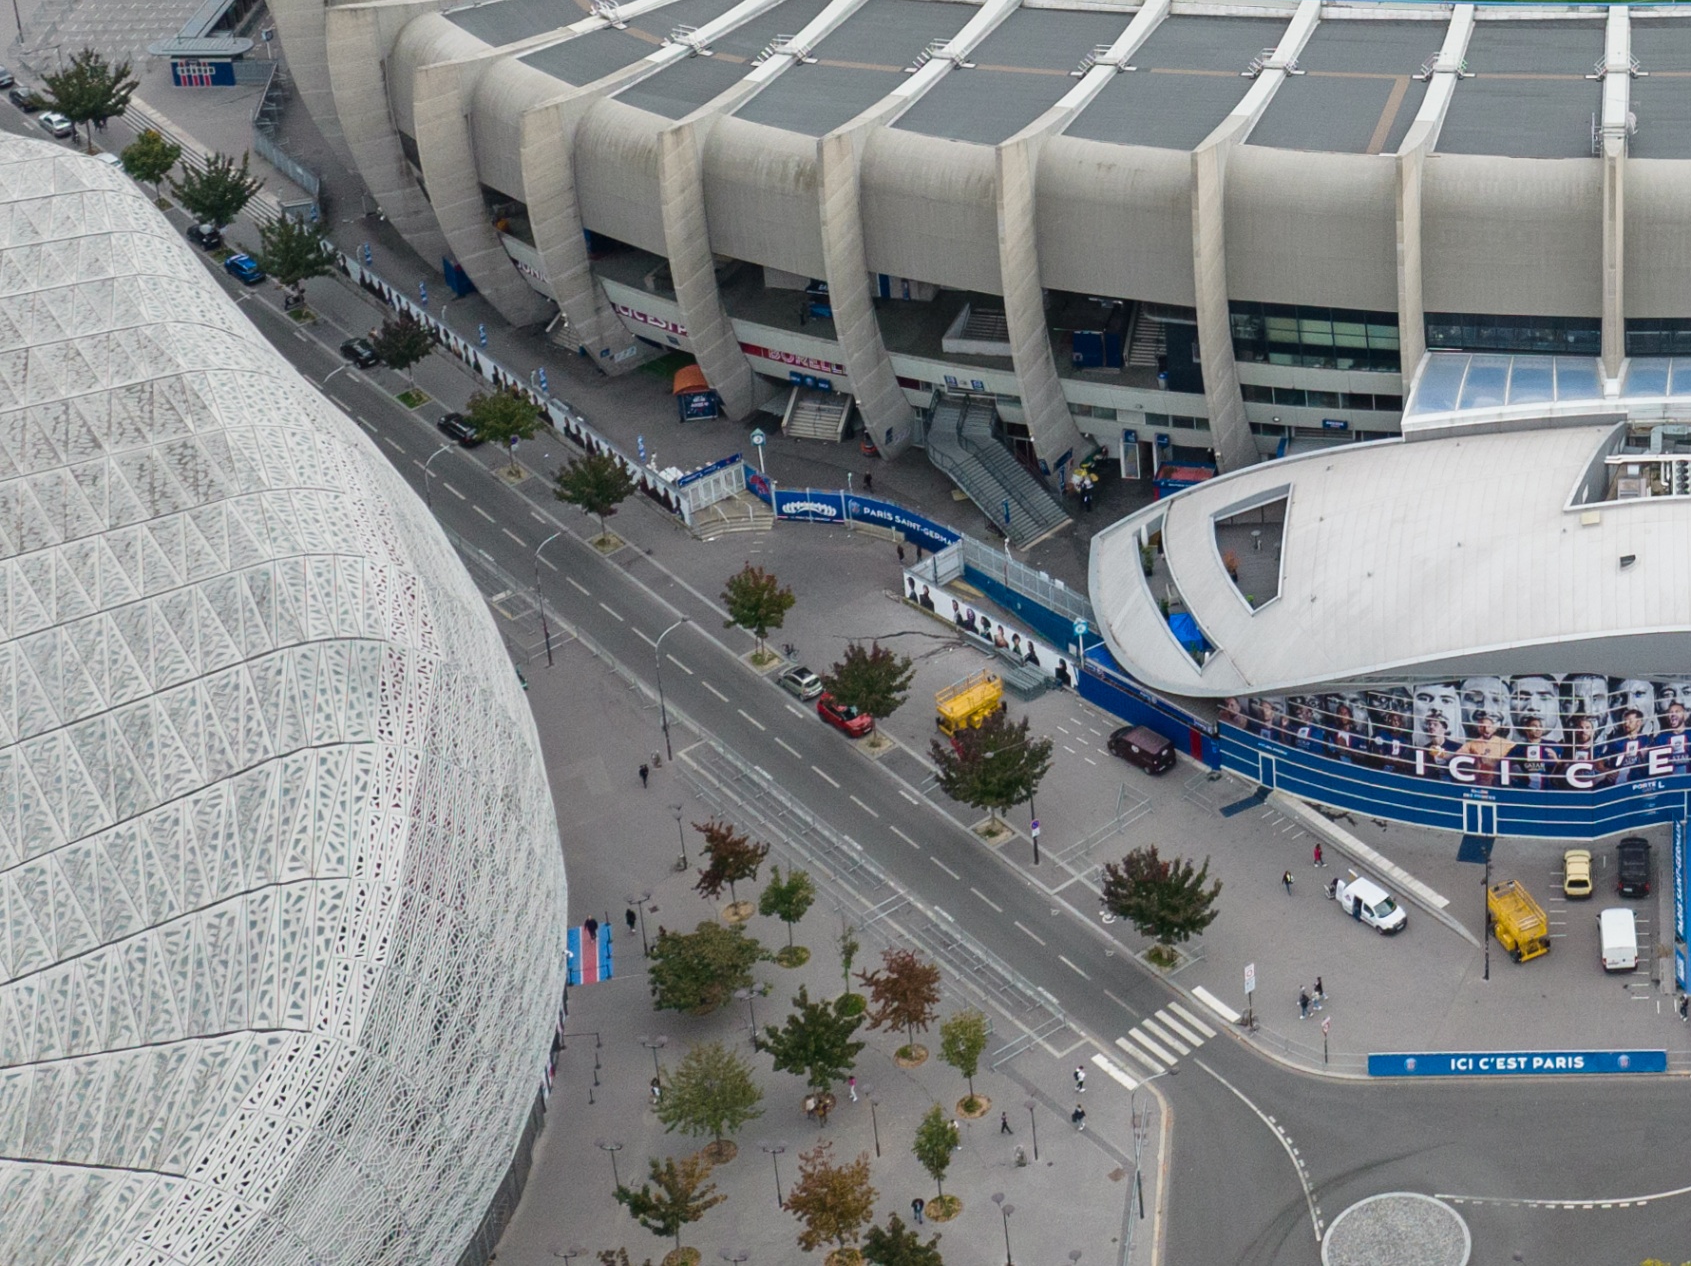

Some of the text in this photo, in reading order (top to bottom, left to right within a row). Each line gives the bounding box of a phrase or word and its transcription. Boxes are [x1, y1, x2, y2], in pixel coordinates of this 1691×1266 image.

[863, 507, 894, 522] PARIS
[1414, 750, 1510, 786] ICI
[1449, 1056, 1585, 1075] ICI C'EST PARIS
